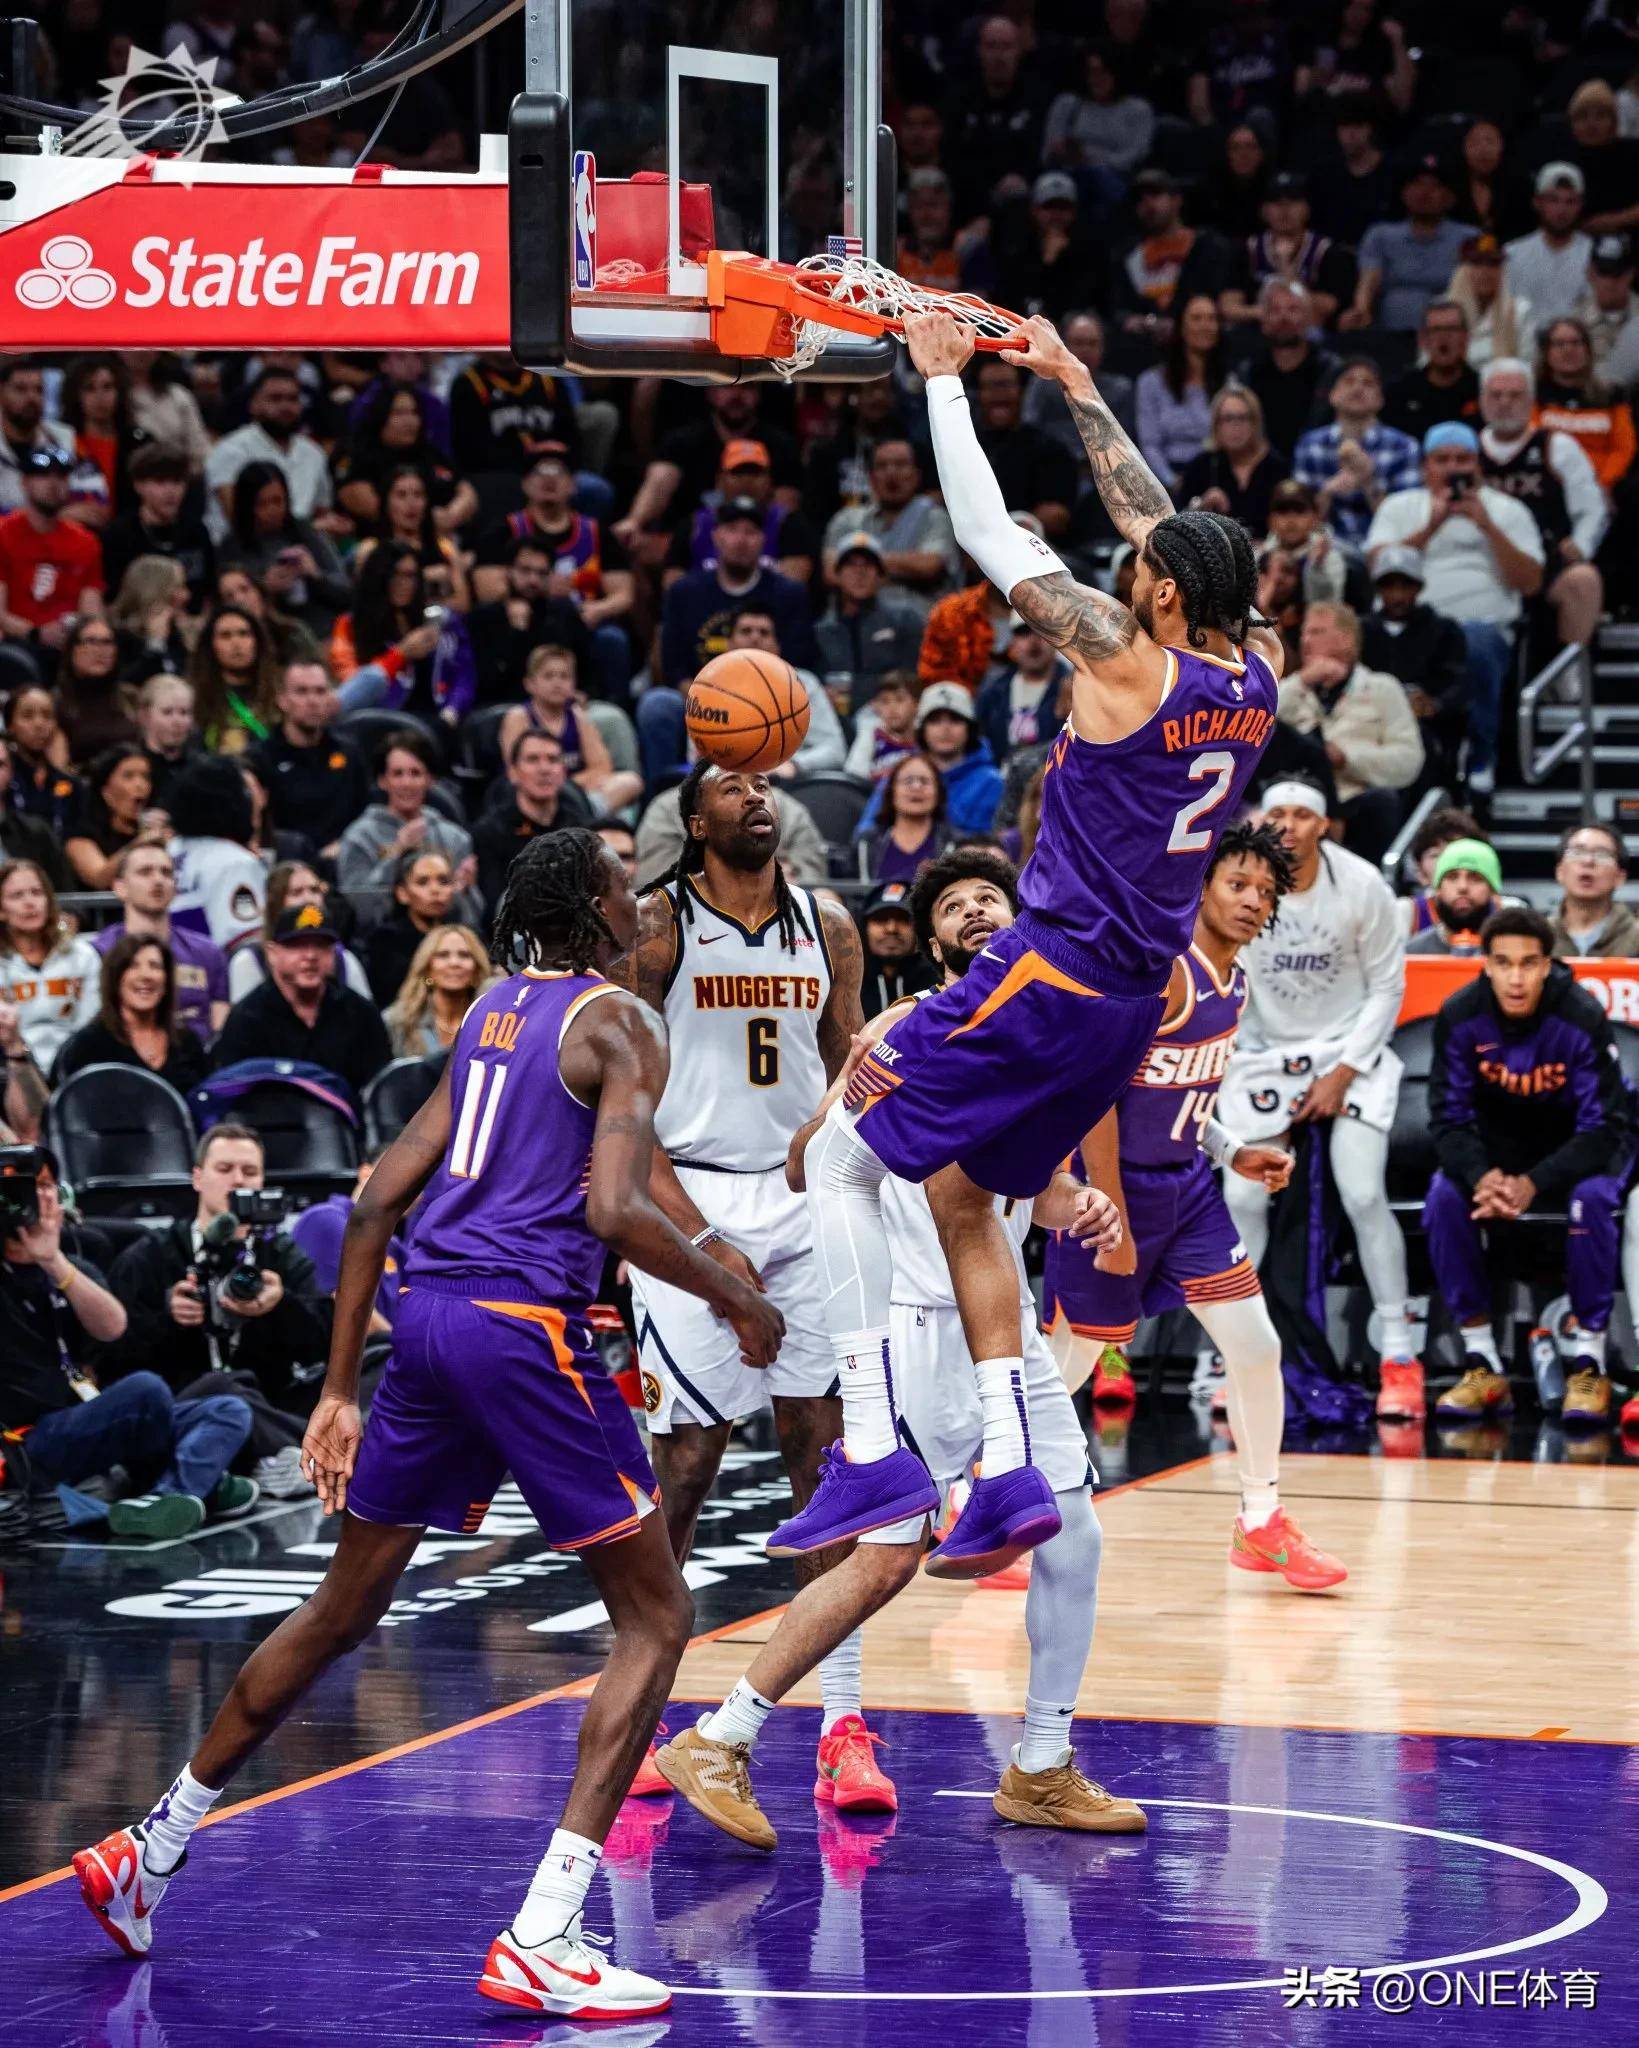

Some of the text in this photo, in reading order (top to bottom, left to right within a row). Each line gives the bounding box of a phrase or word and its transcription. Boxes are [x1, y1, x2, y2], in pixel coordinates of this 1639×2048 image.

[577, 260, 589, 281] NBA
[1162, 708, 1275, 753] RICHARDS
[1166, 751, 1236, 855] 2
[693, 974, 821, 1011] NUGGETS
[479, 1011, 527, 1052] BOL
[746, 1016, 781, 1088] 6
[450, 1059, 507, 1180] 11
[1170, 1090, 1219, 1142] 14
